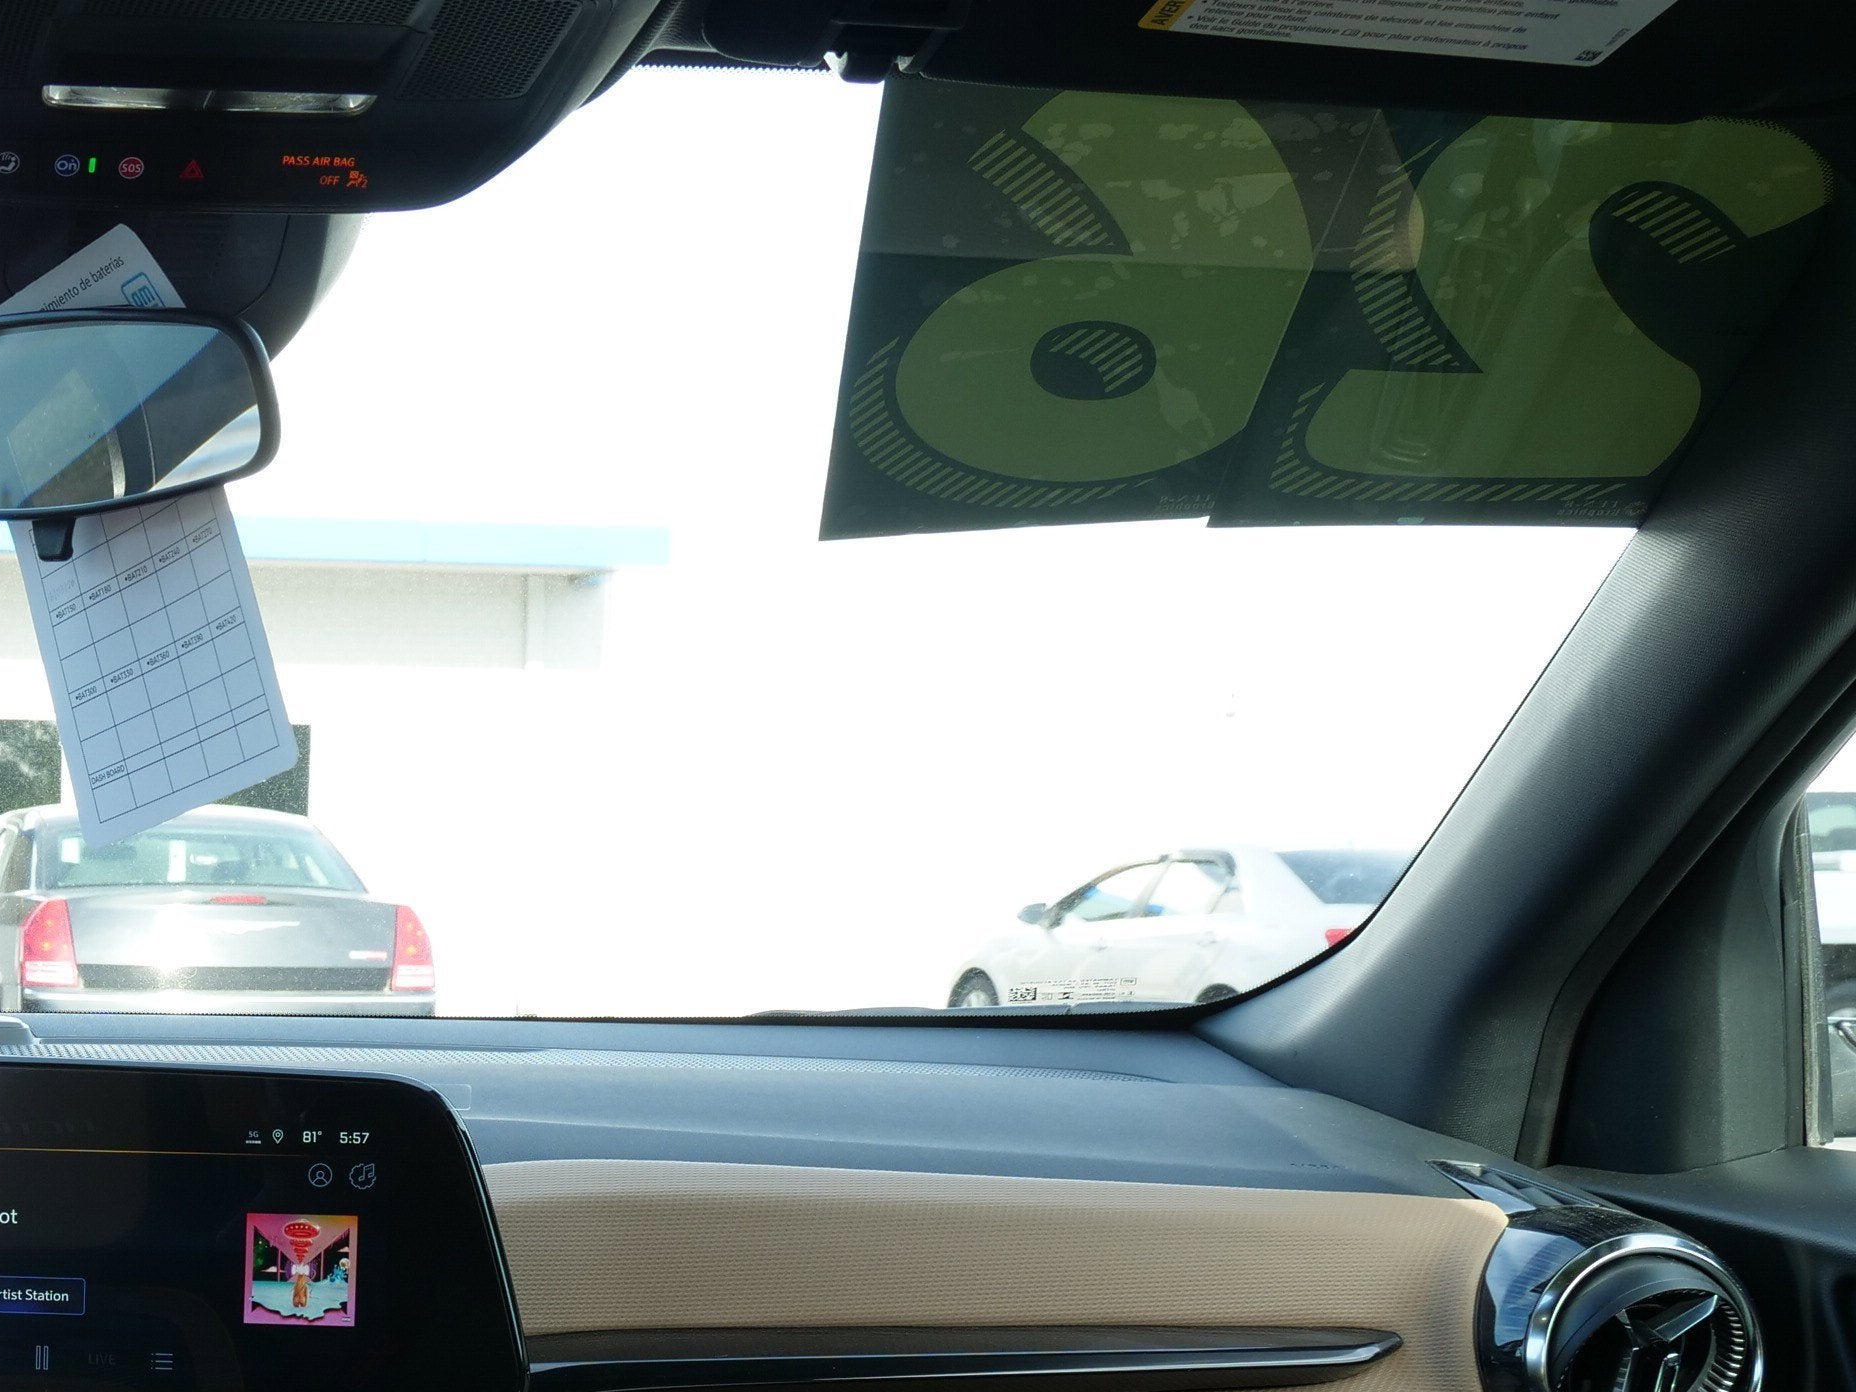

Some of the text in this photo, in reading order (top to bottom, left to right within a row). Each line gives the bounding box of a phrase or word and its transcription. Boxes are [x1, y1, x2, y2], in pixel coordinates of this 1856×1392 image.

[282, 155, 355, 167] PASS AIR BAG
[121, 164, 141, 173] SOS
[319, 175, 340, 185] OFF
[79, 256, 125, 291] de baterías
[302, 1131, 322, 1143] 81°
[339, 1132, 369, 1143] 5:57
[25, 1289, 69, 1301] Station
[88, 1354, 115, 1365] LIVE
